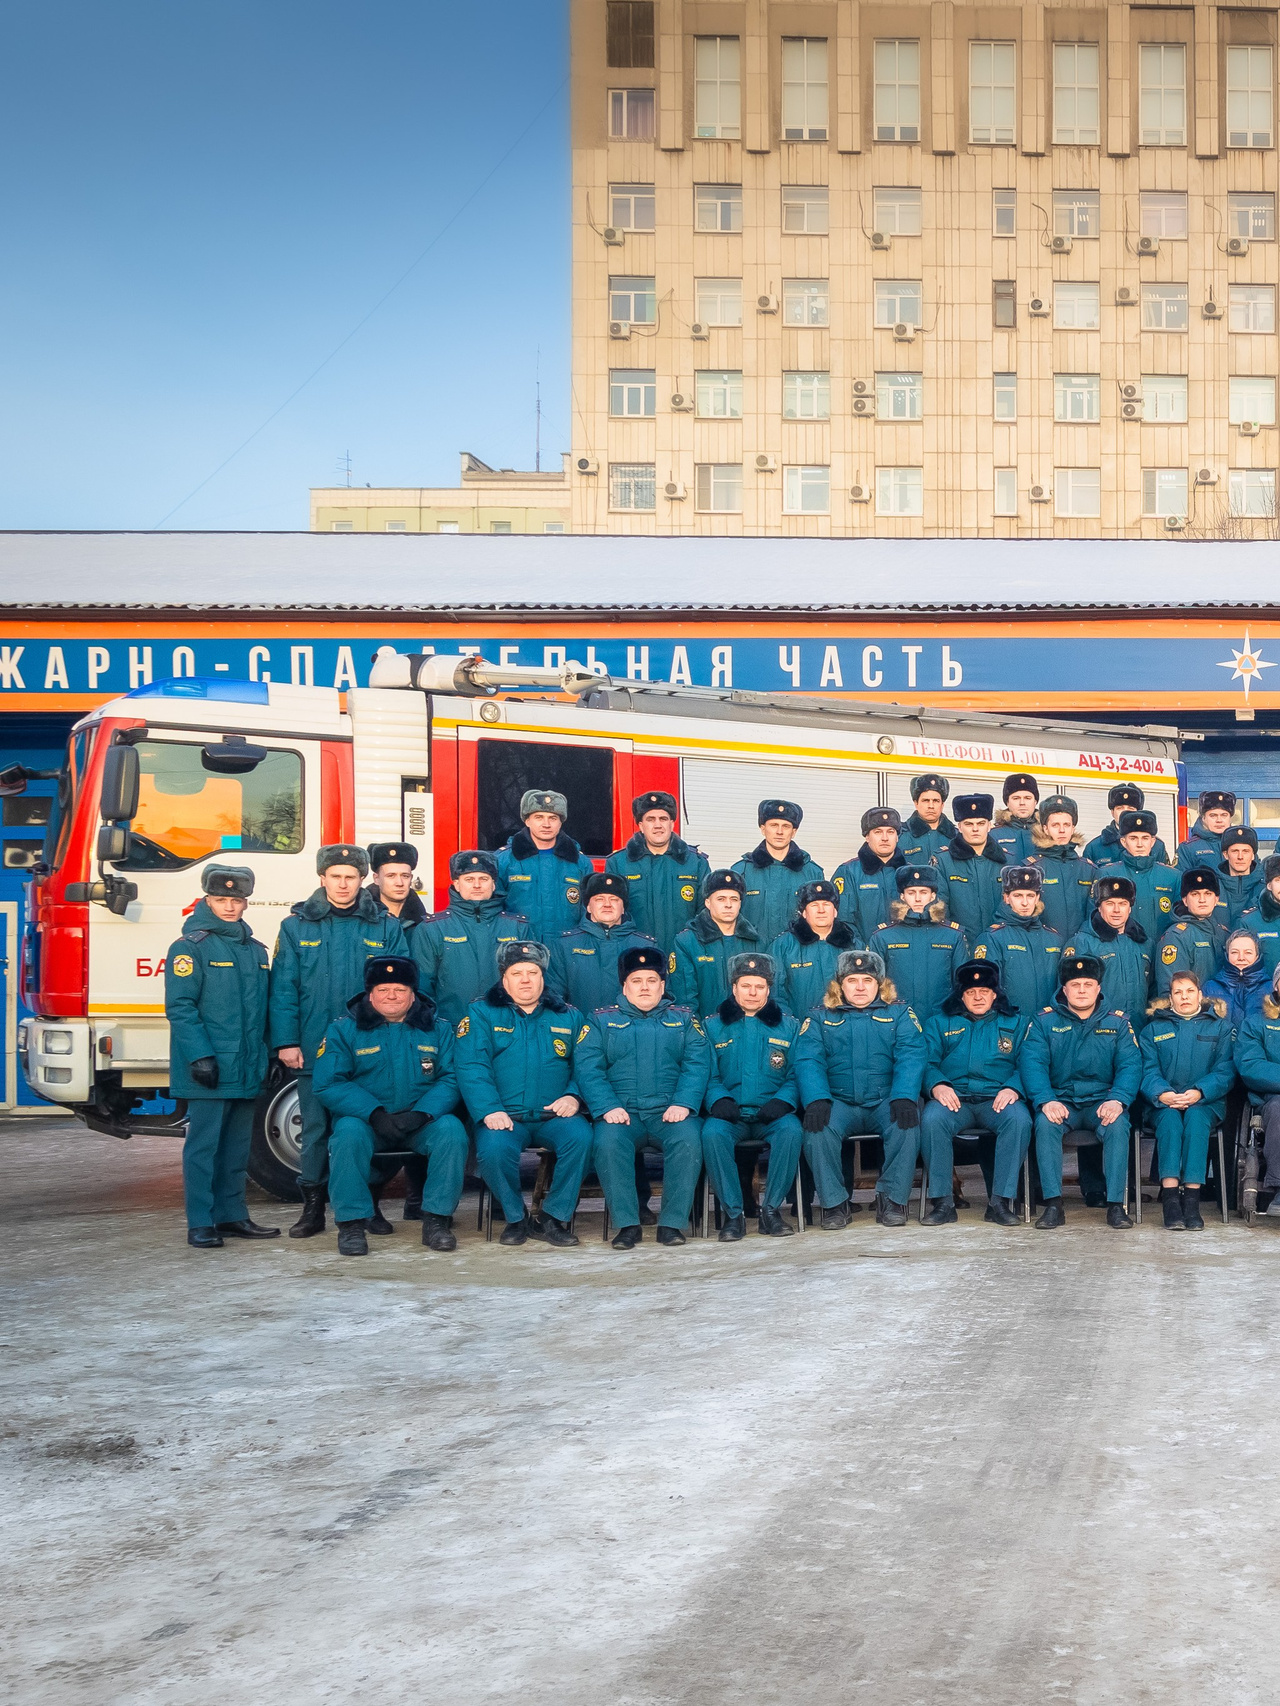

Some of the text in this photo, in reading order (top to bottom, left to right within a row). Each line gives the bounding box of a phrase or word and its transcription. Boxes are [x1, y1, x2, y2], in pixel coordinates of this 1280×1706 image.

[779, 645, 963, 688] ЧАСТЬ
[908, 740, 993, 762] ТЕЛЕФОН
[1078, 753, 1164, 774] АЦ-3,2-40/4
